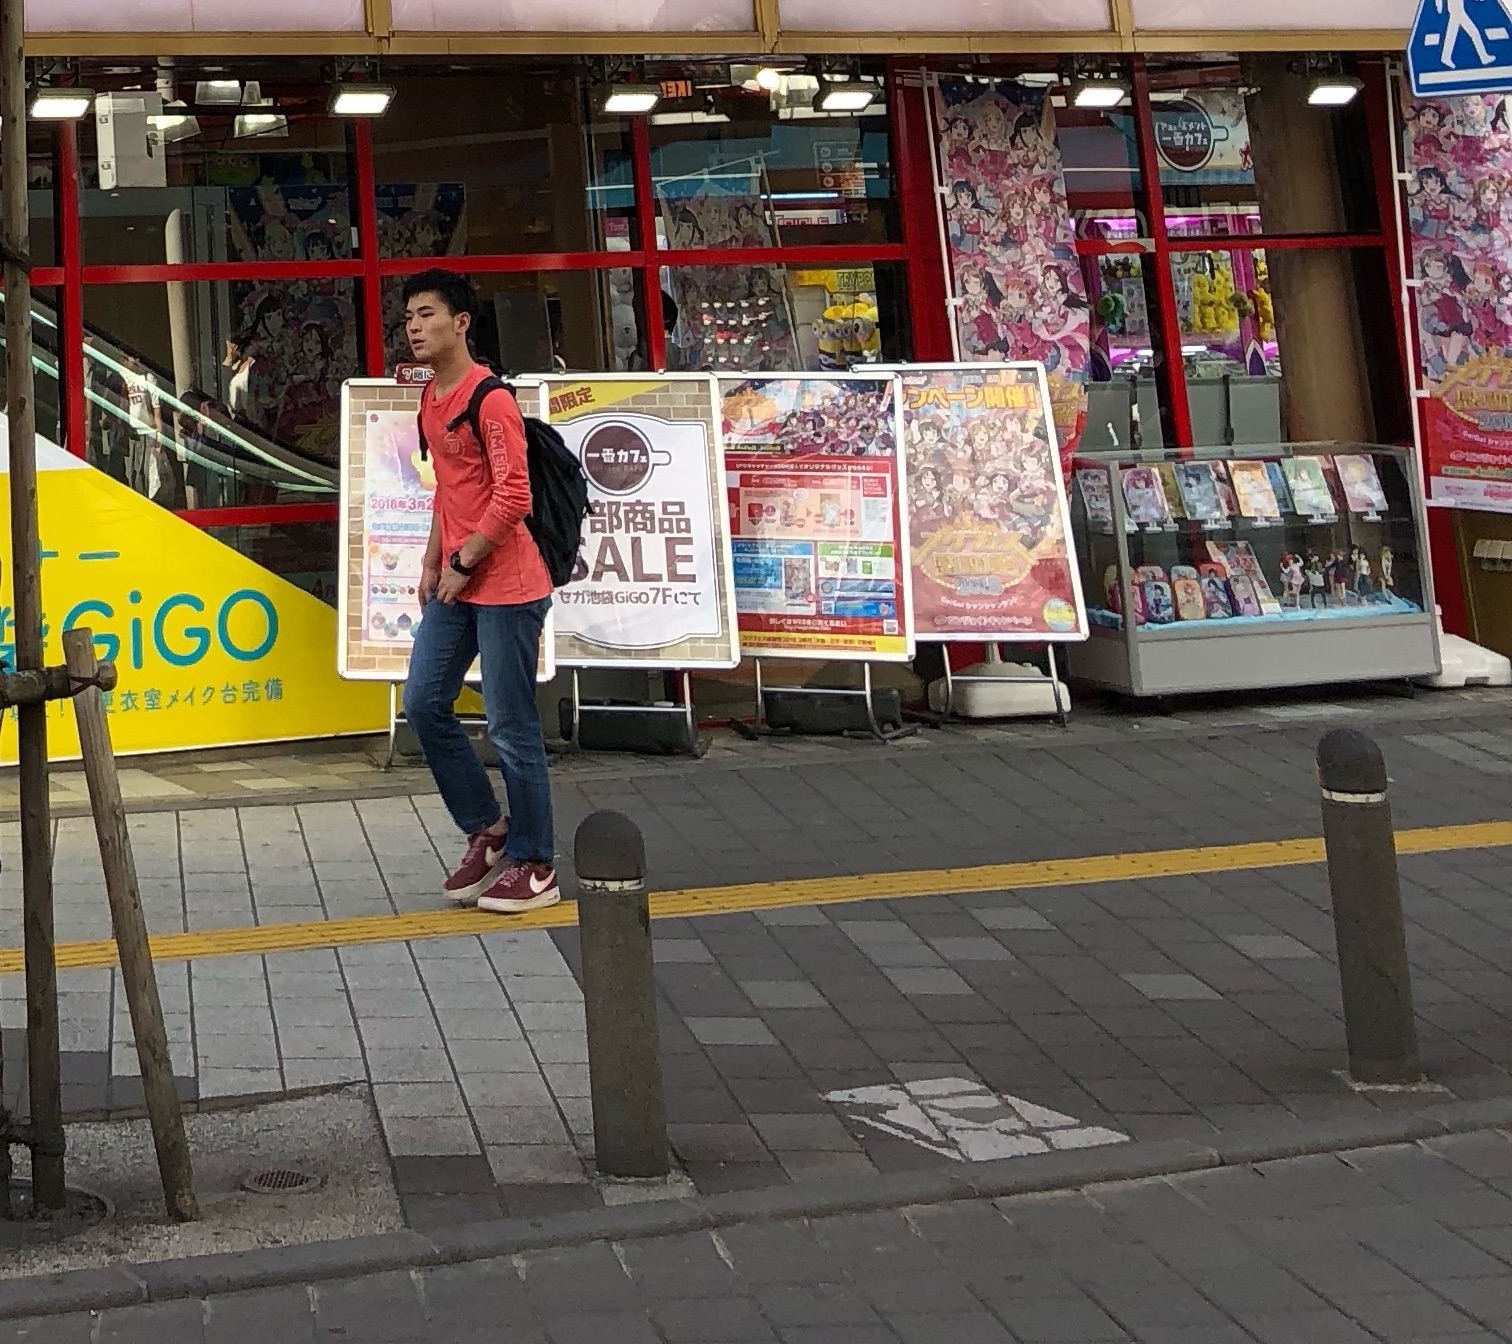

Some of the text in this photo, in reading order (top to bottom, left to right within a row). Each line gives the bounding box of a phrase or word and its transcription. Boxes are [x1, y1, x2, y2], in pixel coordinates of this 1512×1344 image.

[904, 385, 1038, 409] ンペーン開催!
[587, 448, 648, 463] 一番カフェ
[585, 499, 692, 534] 部商品
